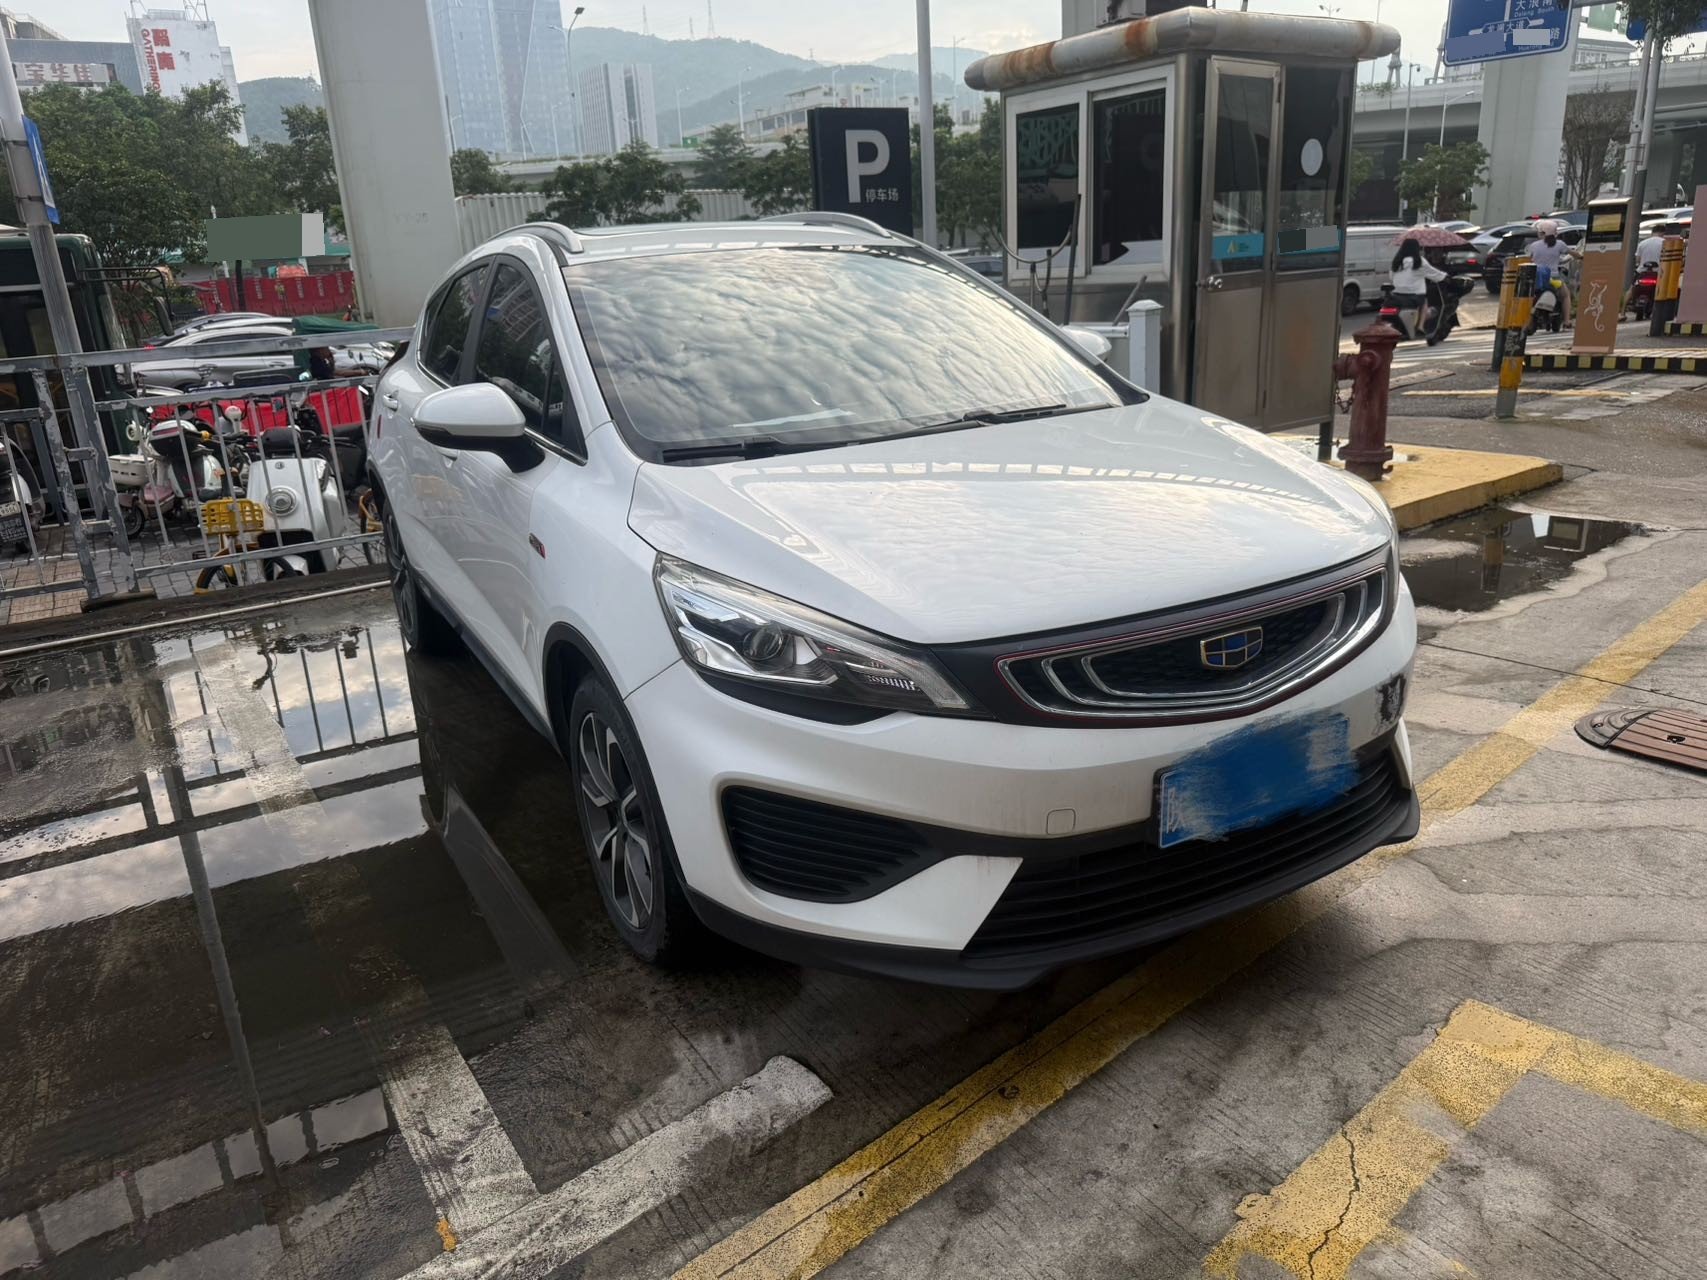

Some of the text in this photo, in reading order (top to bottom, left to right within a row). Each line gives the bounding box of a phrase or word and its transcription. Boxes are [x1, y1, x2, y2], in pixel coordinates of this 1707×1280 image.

[141, 28, 161, 91] GATHERING
[845, 130, 890, 203] P
[865, 188, 899, 202] 停车场
